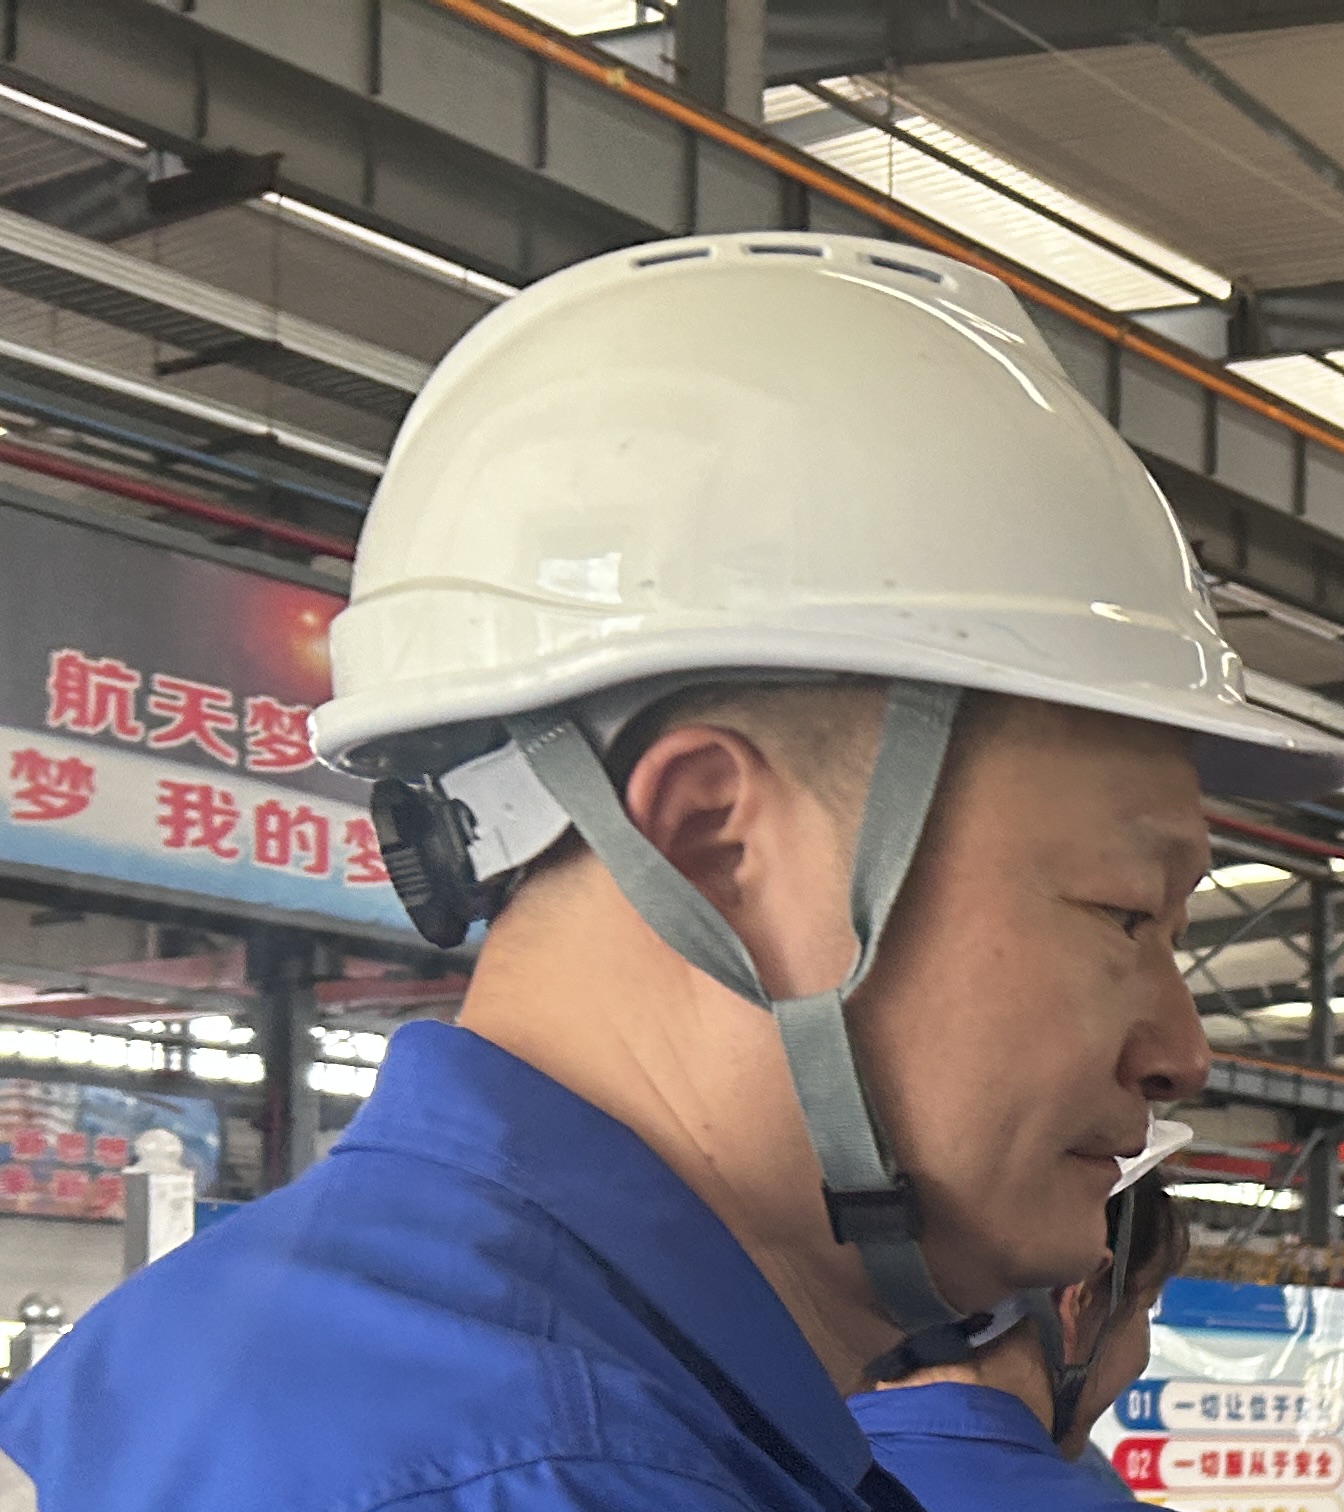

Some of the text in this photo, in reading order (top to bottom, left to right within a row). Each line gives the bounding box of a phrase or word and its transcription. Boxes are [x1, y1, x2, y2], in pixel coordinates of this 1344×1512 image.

[48, 648, 318, 772] 航天梦
[9, 748, 95, 822] 梦
